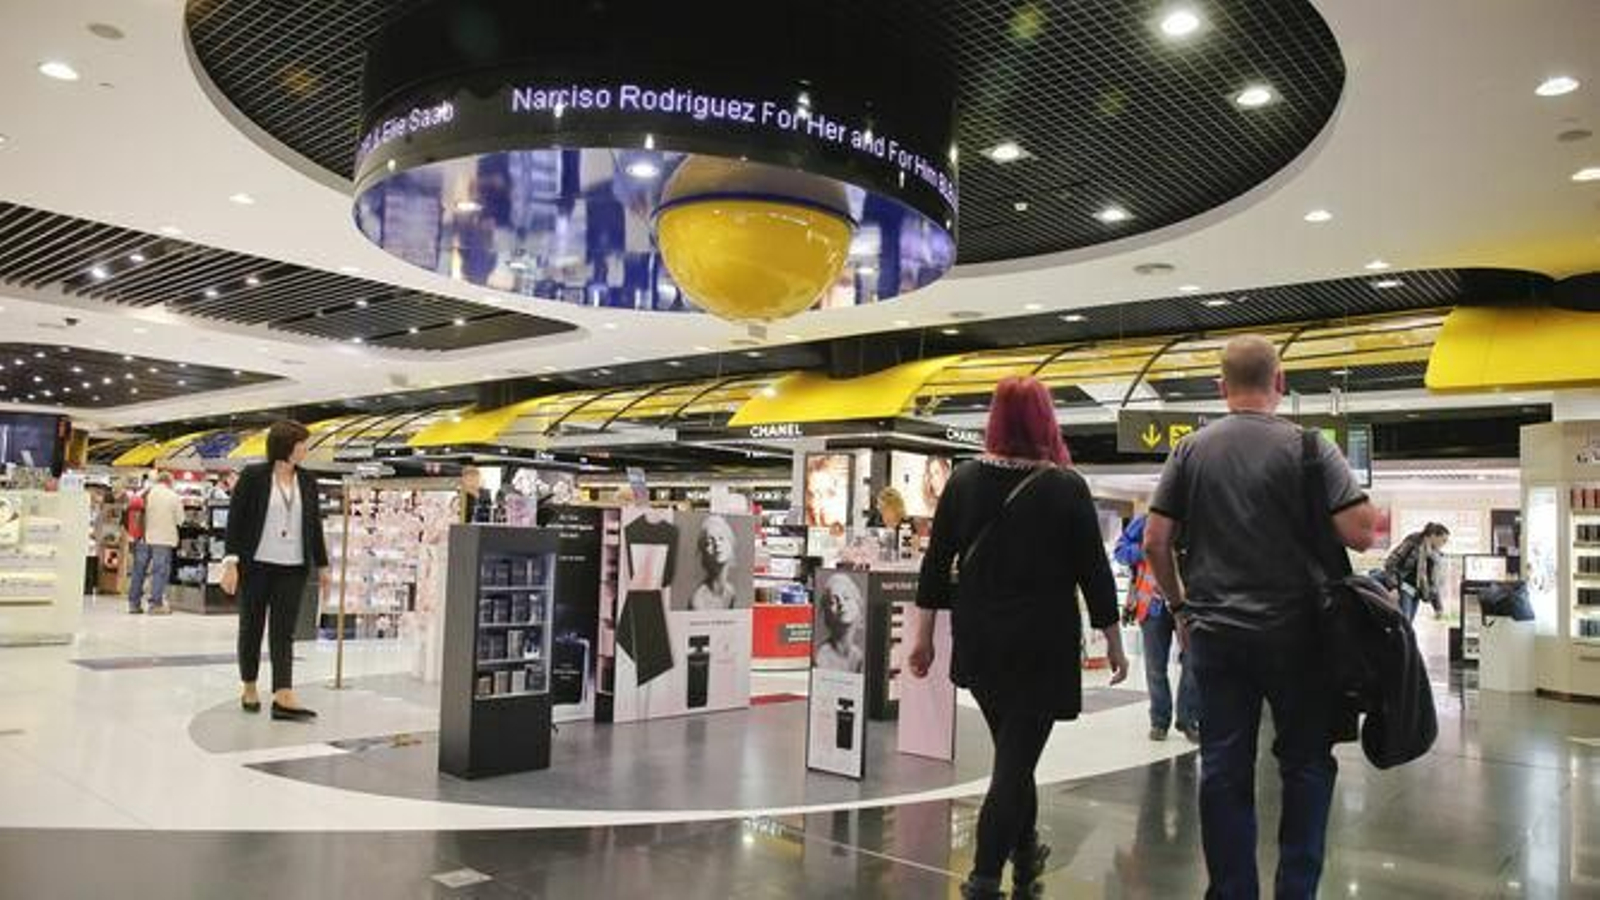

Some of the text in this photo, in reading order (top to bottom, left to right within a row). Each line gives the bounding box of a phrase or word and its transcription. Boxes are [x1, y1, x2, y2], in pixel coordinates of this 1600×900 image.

[408, 100, 454, 132] Saab
[511, 84, 611, 113] Narciso
[618, 84, 756, 123] Rodriguez
[761, 102, 802, 131] For
[805, 112, 846, 144] Her
[850, 130, 885, 158] and
[888, 140, 914, 172] For
[749, 423, 803, 438] CHANEL
